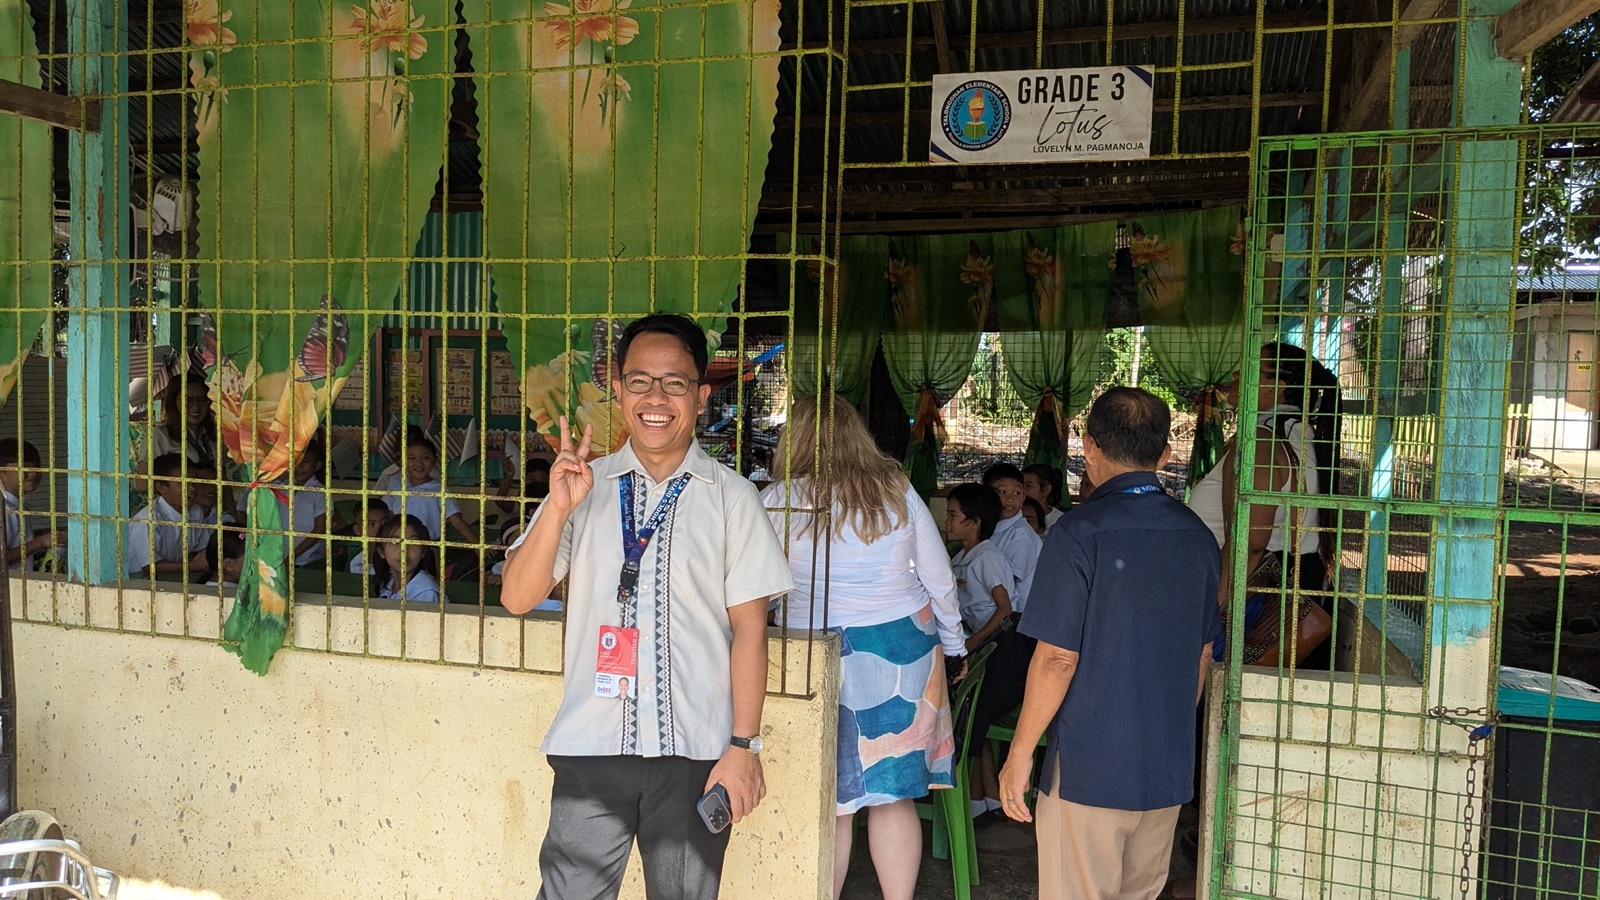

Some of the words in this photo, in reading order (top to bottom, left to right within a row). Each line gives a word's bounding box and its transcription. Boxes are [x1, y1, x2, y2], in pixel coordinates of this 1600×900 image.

[965, 81, 1004, 98] ELEMENTARY
[1001, 96, 1010, 125] SCHOOL
[1017, 74, 1100, 104] GRADE
[1111, 72, 1125, 101] 3
[1037, 103, 1113, 149] Lotus
[1033, 144, 1072, 153] LOVELYN
[1074, 144, 1085, 152] M.
[1086, 142, 1144, 152] PAGMANOJA
[645, 498, 668, 529] SCHOOLS
[665, 474, 684, 498] DIVISIO
[651, 492, 679, 529] PASSI
[630, 639, 638, 665] TEACHER
